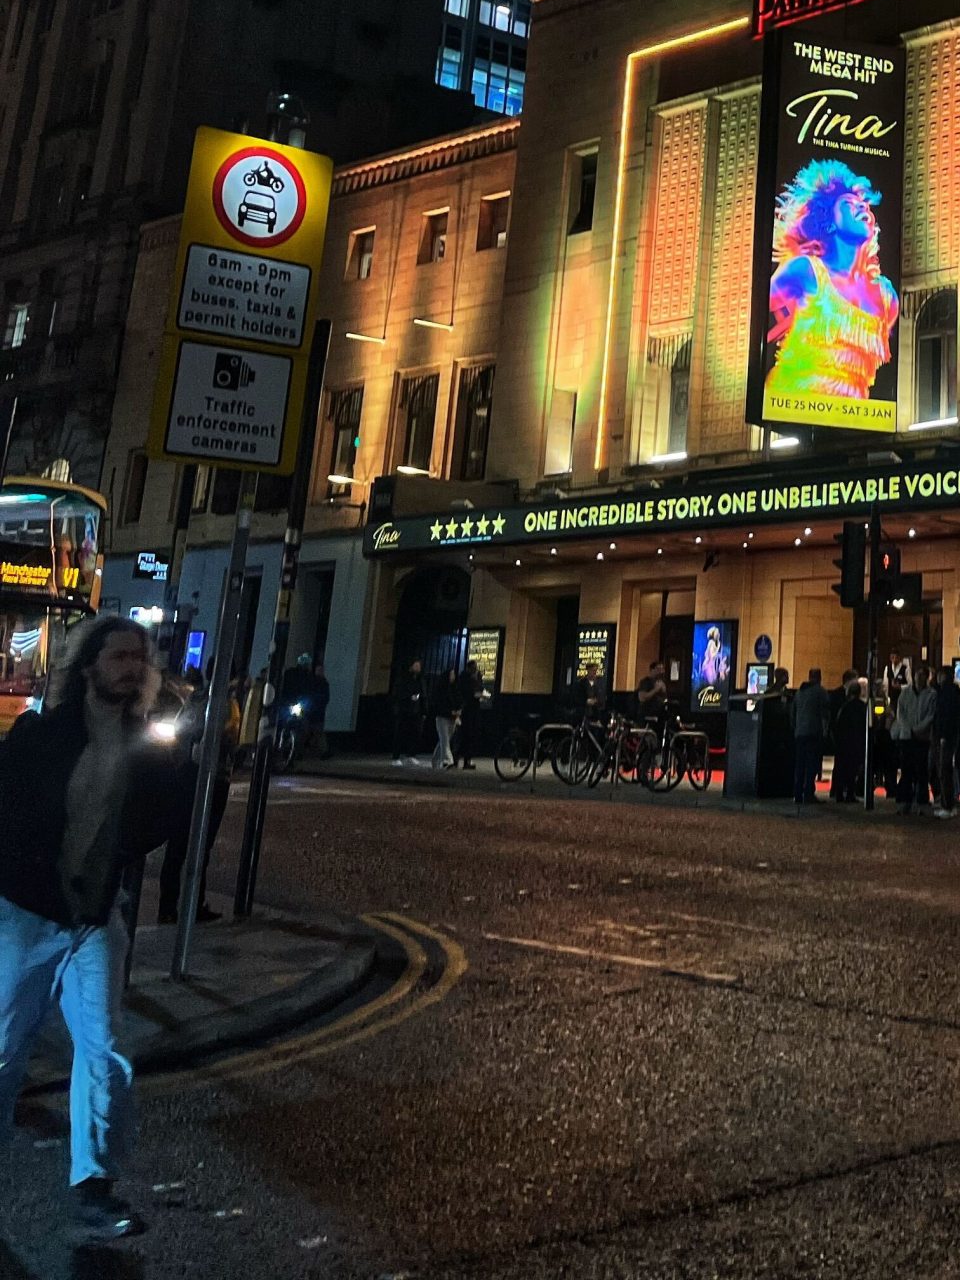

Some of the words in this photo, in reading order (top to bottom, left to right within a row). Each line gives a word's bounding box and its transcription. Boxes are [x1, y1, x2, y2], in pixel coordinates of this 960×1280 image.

[793, 41, 821, 61] THE
[824, 47, 861, 67] WEST
[864, 55, 894, 73] END
[809, 60, 851, 81] MEGA
[854, 67, 878, 84] HIT
[786, 89, 897, 144] Tina
[812, 137, 824, 146] THE
[825, 140, 840, 149] TINA
[840, 142, 864, 153] TURNER
[864, 146, 890, 158] MUSICAL
[258, 263, 292, 283] 9pm
[208, 273, 259, 294] except
[264, 284, 285, 299] for
[246, 298, 281, 317] taxis
[287, 306, 296, 320] &
[184, 308, 237, 330] permit
[241, 317, 297, 339] holders
[204, 396, 255, 417] Traffic
[770, 397, 792, 409] TUE
[794, 400, 806, 410] 25
[808, 401, 833, 413] NOV
[842, 404, 861, 416] SAT
[863, 407, 869, 416] 3
[871, 408, 892, 419] JAN
[176, 413, 278, 439] enforcement
[191, 435, 257, 454] cameras
[524, 509, 557, 533] ONE
[560, 500, 654, 529] INCREDIBLE
[656, 493, 714, 521] STORY.
[717, 491, 756, 515] ONE
[761, 476, 900, 512] UNBELIEVABLE
